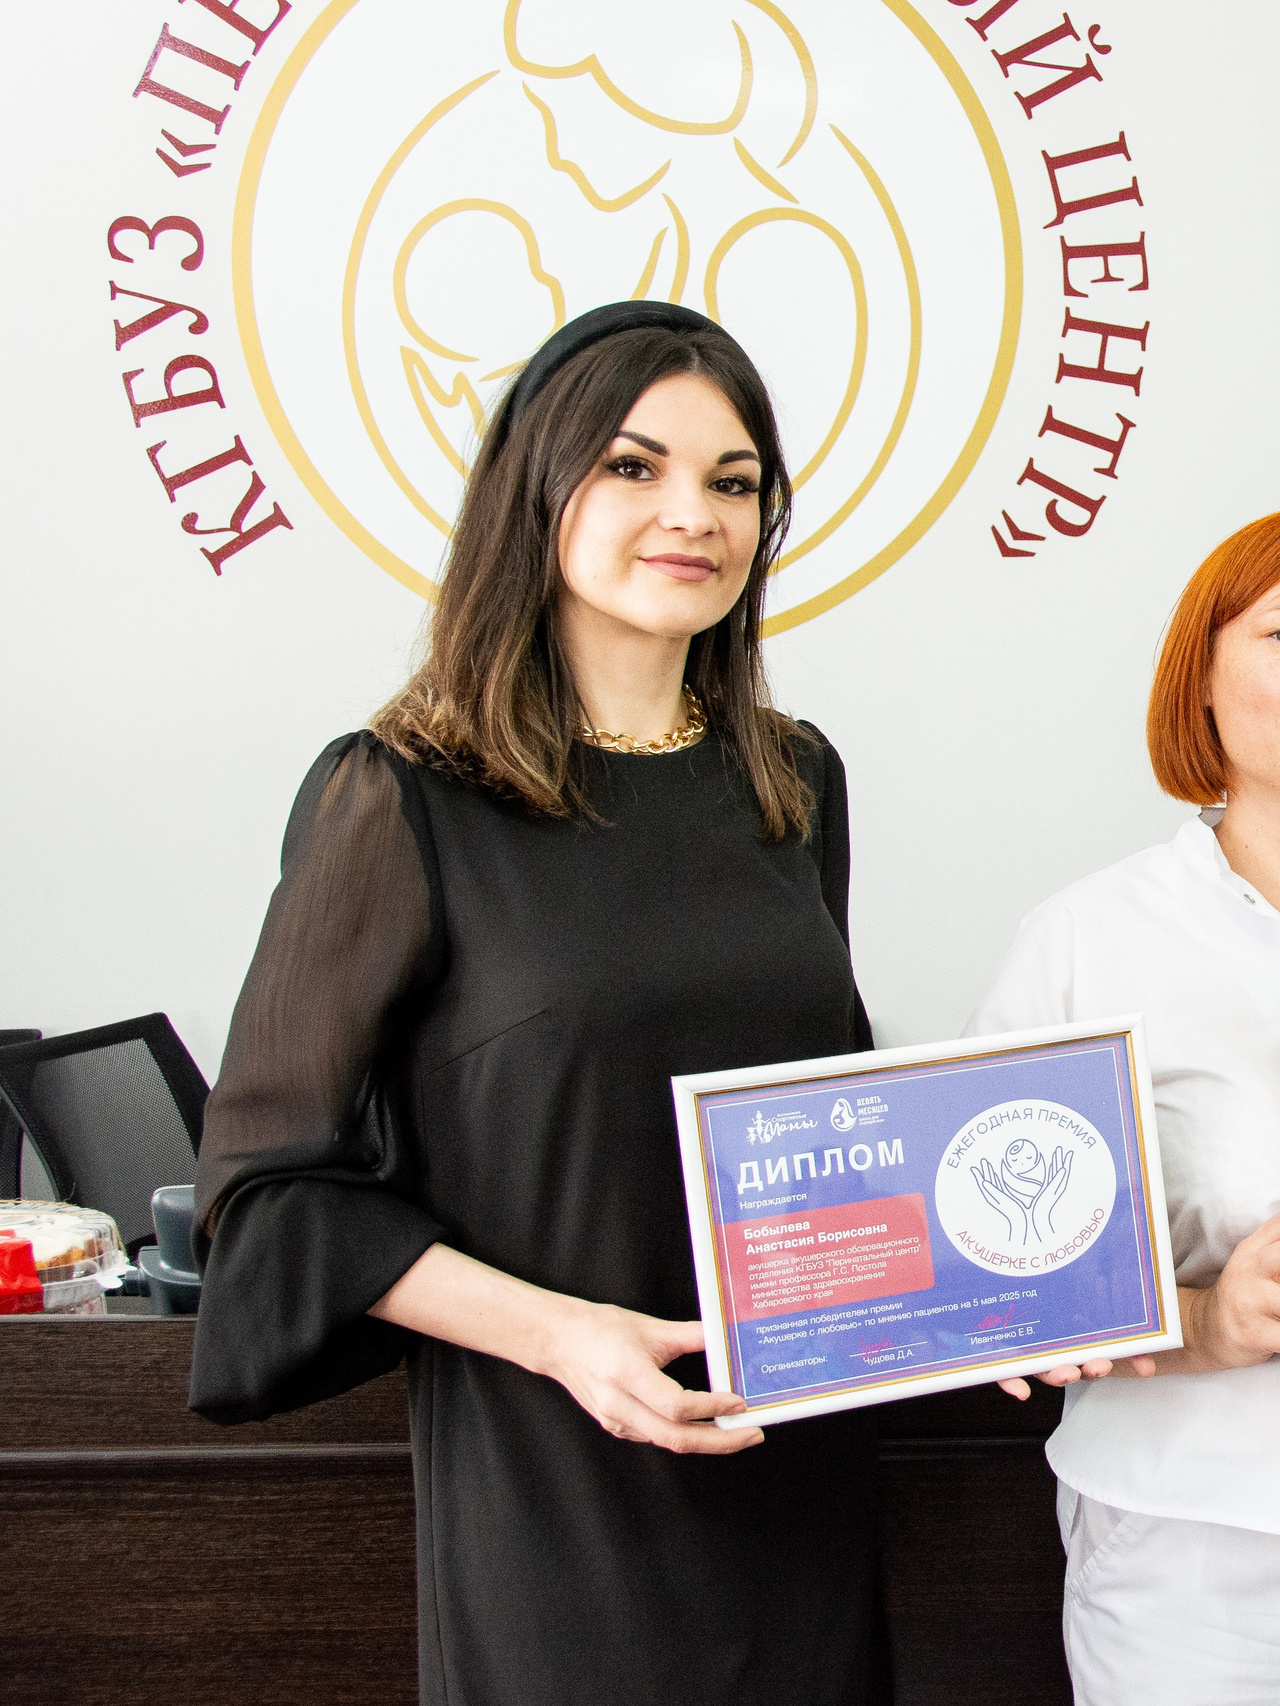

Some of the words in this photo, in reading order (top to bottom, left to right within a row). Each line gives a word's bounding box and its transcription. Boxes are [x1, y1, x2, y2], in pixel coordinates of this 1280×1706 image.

[991, 131, 1150, 557] ЦЕНТР»
[107, 216, 294, 576] КГБУЗ
[856, 1096, 882, 1106] ДЕВЯТЬ
[858, 1104, 889, 1116] МЕСЯЦЕВ
[947, 1108, 1033, 1169] ЕЖЕГОДНАЯ
[1037, 1109, 1097, 1149] ПРЕМИЯ
[737, 1138, 905, 1195] ДИПЛОМ
[739, 1192, 807, 1210] Награждается
[743, 1220, 810, 1240] Бобылева
[746, 1236, 815, 1255] Анастасия
[818, 1223, 888, 1243] Борисовна
[956, 1230, 1027, 1270] АКУШЕРКЕ
[1030, 1257, 1040, 1268] С
[1044, 1207, 1105, 1266] ЛЮБОВЬЮ
[747, 1257, 789, 1272] акушерка
[791, 1250, 845, 1264] акушерского
[847, 1236, 919, 1255] обсервационного
[749, 1267, 793, 1281] отделения
[795, 1261, 824, 1272] КГБУЗ
[750, 1280, 777, 1290] имени
[779, 1270, 831, 1286] профессора
[833, 1267, 850, 1276] Г.С.
[851, 1261, 887, 1273] Постола
[751, 1284, 810, 1300] министерства
[812, 1271, 886, 1290] здравоохранения
[752, 1293, 811, 1309] Хабаровского
[813, 1289, 834, 1298] края
[864, 1318, 875, 1326] по
[878, 1312, 912, 1323] мнению
[913, 1302, 958, 1317] пациентов
[972, 1298, 978, 1306] 5
[980, 1297, 996, 1305] мая
[998, 1291, 1020, 1301] 2025
[1021, 1289, 1037, 1299] год
[756, 1319, 808, 1334] признанная
[809, 1307, 867, 1324] победителем
[869, 1301, 902, 1314] премии
[970, 1330, 1016, 1345] Иванченко
[1017, 1326, 1035, 1336] Е.В.
[761, 1354, 828, 1375] Организаторы:
[896, 1349, 915, 1359] Д.А.
